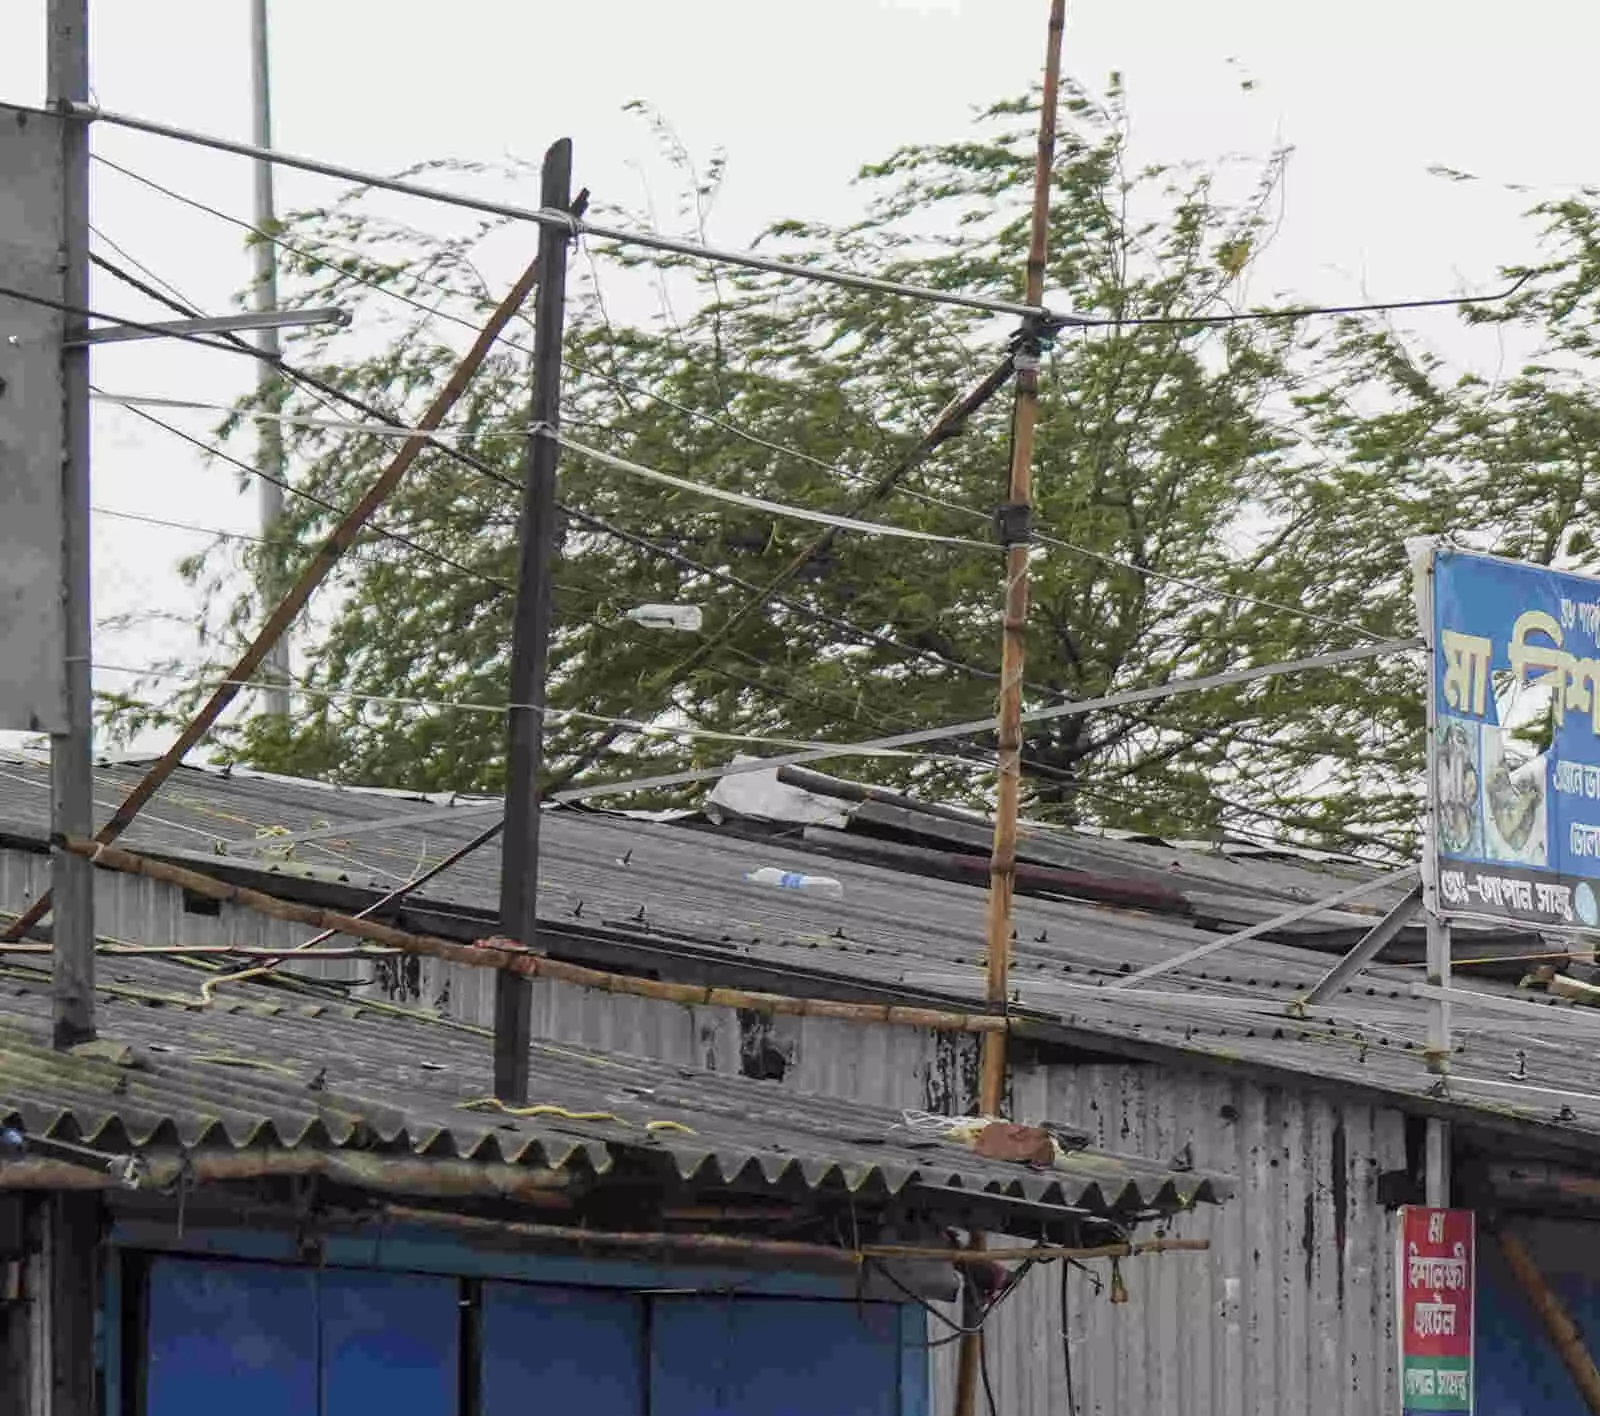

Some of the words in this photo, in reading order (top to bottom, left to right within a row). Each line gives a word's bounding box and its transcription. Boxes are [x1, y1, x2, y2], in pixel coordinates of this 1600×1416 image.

[1441, 629, 1492, 717] মা
[1428, 1211, 1447, 1245] মা
[1413, 1291, 1457, 1339] হোটেল
